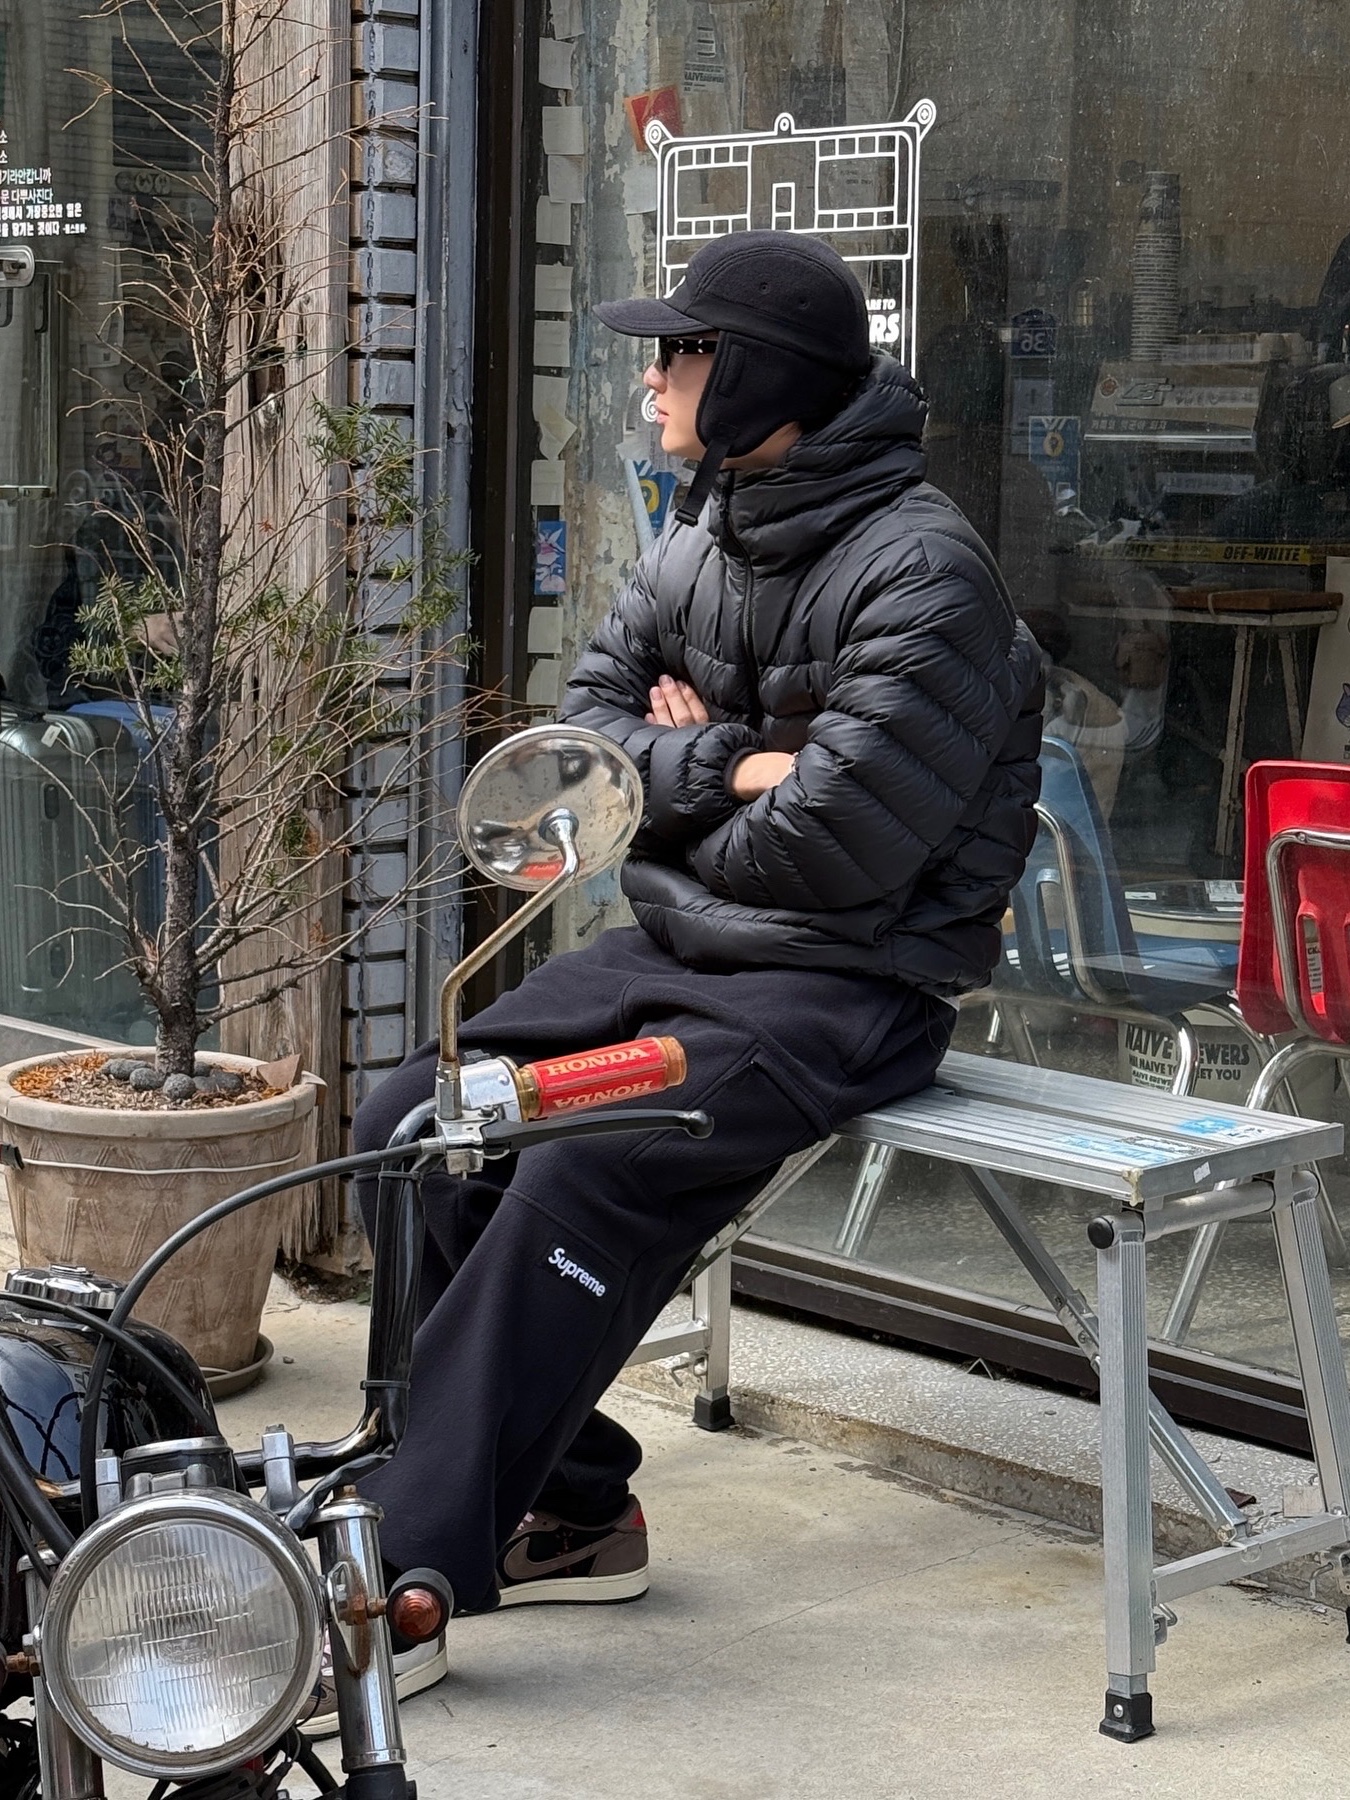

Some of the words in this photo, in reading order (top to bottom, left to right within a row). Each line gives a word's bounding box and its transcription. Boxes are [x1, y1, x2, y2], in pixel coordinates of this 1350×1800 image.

[868, 313, 900, 343] RS
[1223, 545, 1301, 561] OFF-WHITE
[1125, 1023, 1174, 1060] NAIVE
[546, 1047, 651, 1077] HONDA
[1139, 1058, 1166, 1075] NAIVE
[1215, 1068, 1241, 1081] YOU
[553, 1080, 653, 1109] HONDA
[547, 1247, 607, 1297] Supreme
